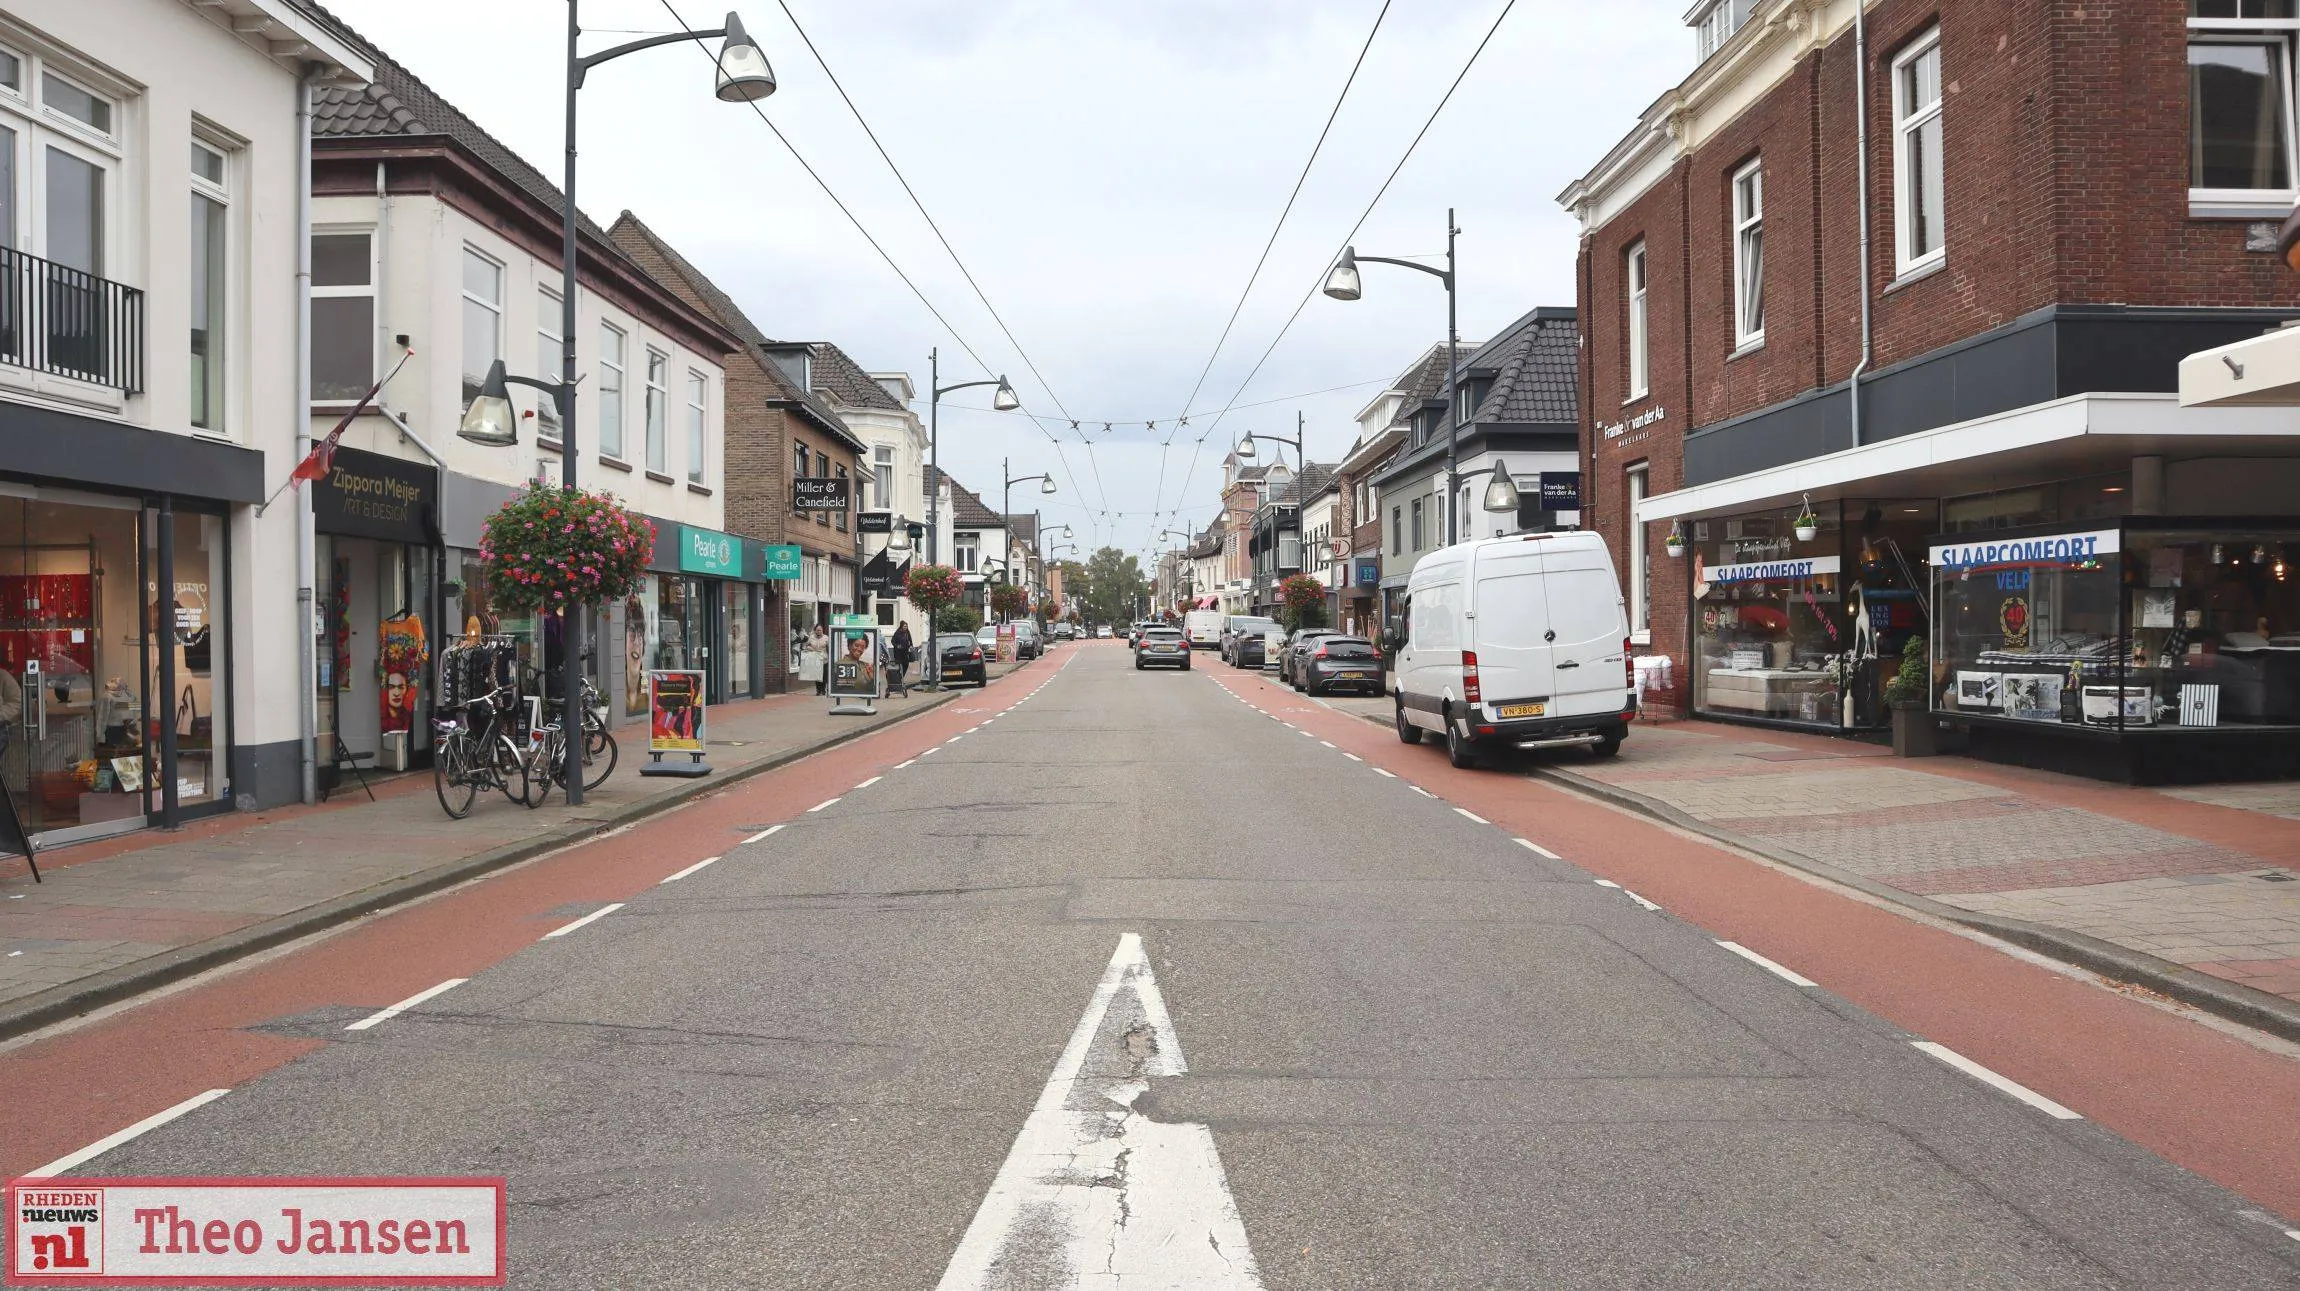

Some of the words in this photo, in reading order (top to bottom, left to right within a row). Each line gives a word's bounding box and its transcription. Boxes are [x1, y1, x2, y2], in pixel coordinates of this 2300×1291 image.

[1604, 421, 1624, 440] Franke
[1632, 415, 1644, 430] van
[1644, 409, 1655, 425] der
[1655, 404, 1664, 421] Aa
[1618, 430, 1649, 447] MAKELAARS
[332, 466, 382, 496] Zippora
[385, 476, 420, 506] Meijer
[796, 482, 824, 493] Miller
[826, 482, 837, 493] &
[796, 495, 846, 507] Canefield
[363, 503, 370, 517] &
[372, 502, 408, 524] DESIGN
[694, 534, 716, 558] Pearle
[1942, 536, 2098, 572] SLAAPCOMFORT
[769, 562, 798, 571] Pearle
[1717, 561, 1814, 584] SLAAPCOMFORT
[1996, 571, 2030, 590] VELP
[1705, 611, 1716, 624] 40
[2007, 607, 2024, 623] 40
[838, 665, 846, 678] 3
[851, 666, 856, 677] 1
[1503, 705, 1541, 715] VN-380-S
